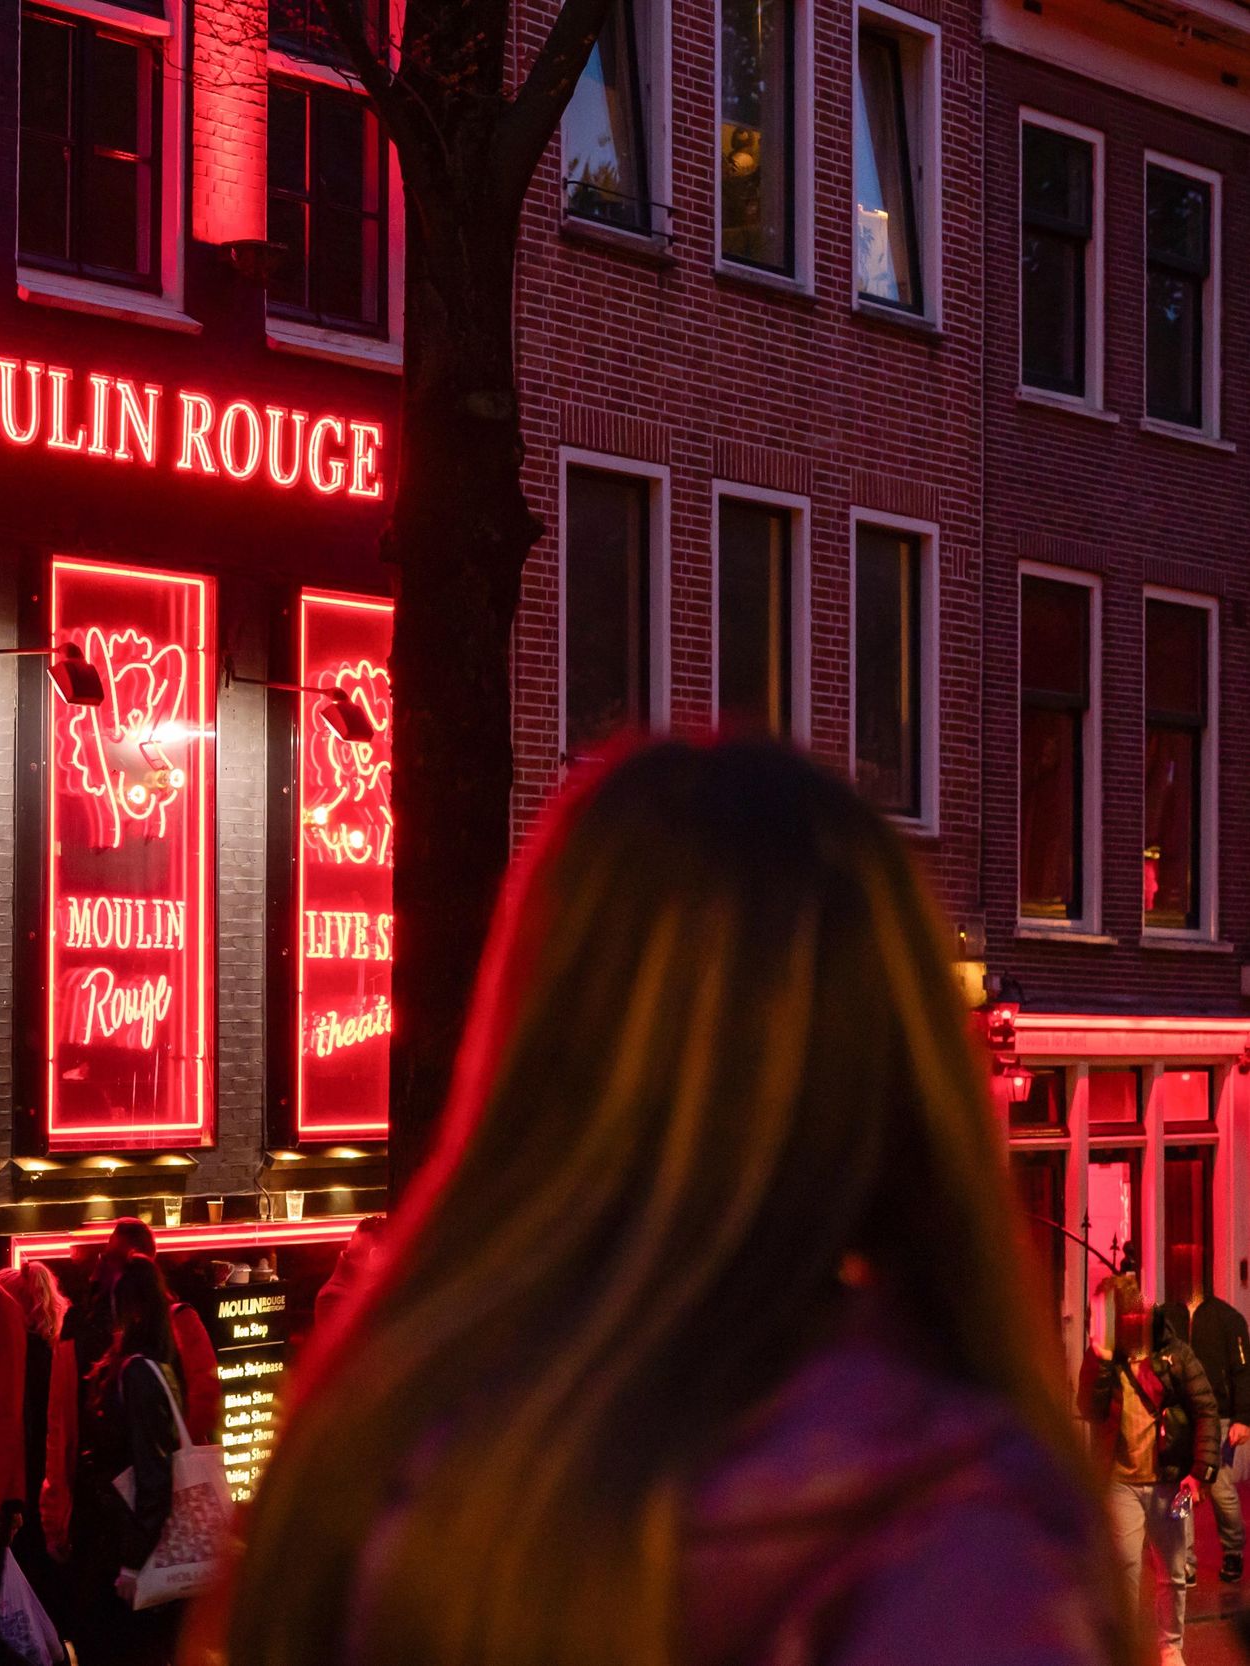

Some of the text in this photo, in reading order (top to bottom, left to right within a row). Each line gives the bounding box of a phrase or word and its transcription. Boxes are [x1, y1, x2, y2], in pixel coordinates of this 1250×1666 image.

[176, 389, 385, 500] ROUGE
[65, 896, 186, 951] MOULIN
[305, 910, 394, 961] LIVE S
[81, 966, 173, 1050] Rouge
[315, 995, 393, 1058] theat
[217, 1297, 263, 1318] MOULIN
[233, 1322, 269, 1339] Non Stop
[217, 1361, 284, 1380] Female Striptease
[252, 1391, 274, 1405] Show
[251, 1409, 272, 1424] Show
[253, 1428, 274, 1442] Show
